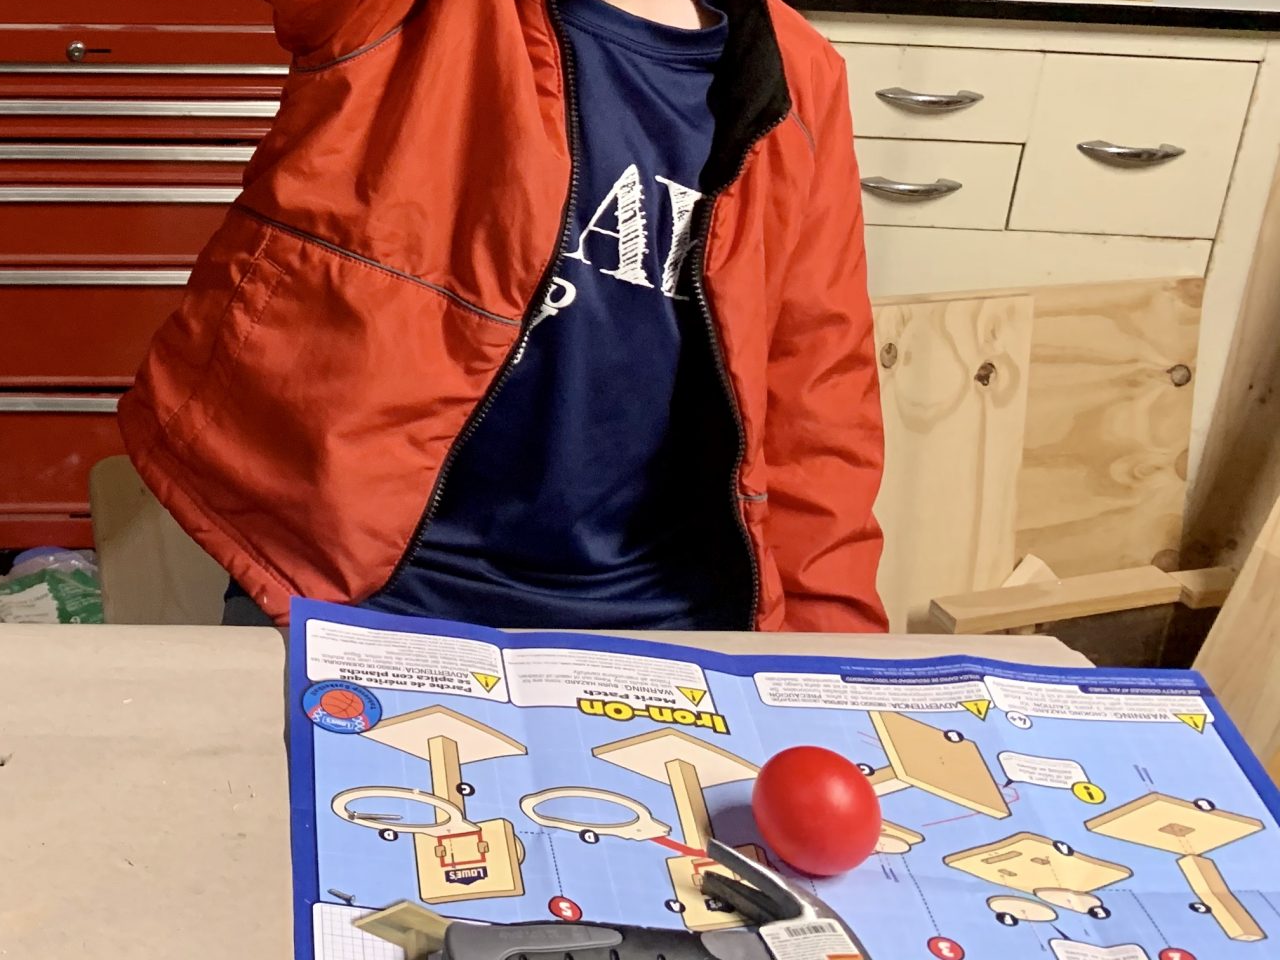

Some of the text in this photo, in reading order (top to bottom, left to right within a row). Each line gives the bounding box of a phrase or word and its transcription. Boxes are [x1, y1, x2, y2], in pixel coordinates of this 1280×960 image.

[339, 667, 389, 678] plancha
[392, 672, 413, 680] con
[411, 680, 426, 688] de
[417, 674, 454, 684] aplica
[429, 682, 472, 693] Parche
[583, 689, 676, 704] Merit Patch
[576, 697, 731, 735] Iron-On
[449, 867, 484, 880] LOWE'S
